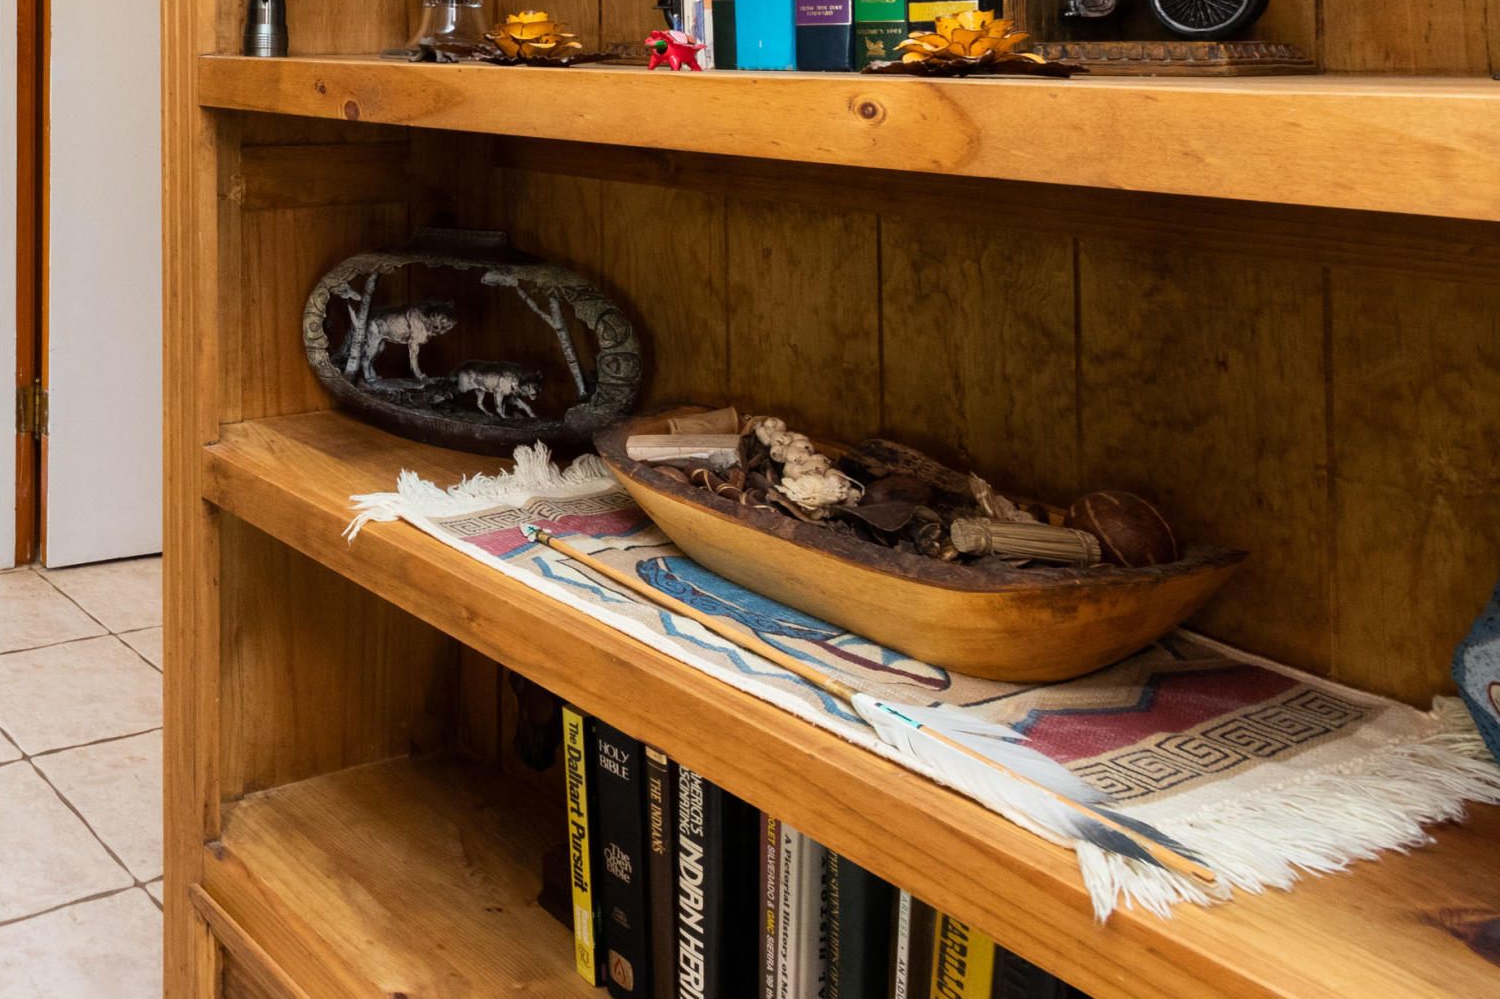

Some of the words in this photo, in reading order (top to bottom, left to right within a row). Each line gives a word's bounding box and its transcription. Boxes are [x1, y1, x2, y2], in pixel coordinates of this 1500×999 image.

[569, 722, 580, 745] The
[599, 739, 630, 763] HOLY
[599, 754, 630, 781] BIBLE
[567, 744, 584, 818] Dalhart
[650, 777, 662, 803] THE
[651, 803, 665, 855] INDIANS
[767, 814, 776, 845] OLET
[785, 834, 792, 845] A
[571, 819, 588, 893] Pursuit
[604, 847, 632, 873] Open
[610, 842, 630, 861] The
[606, 860, 631, 883] Bible
[679, 834, 704, 934] INDIAN
[766, 845, 776, 900] SILVERADO
[783, 850, 792, 908] Pictorial
[766, 901, 775, 909] &
[766, 910, 775, 935] GMC
[781, 908, 791, 959] History
[766, 934, 775, 971] SIERRA
[781, 960, 788, 974] of
